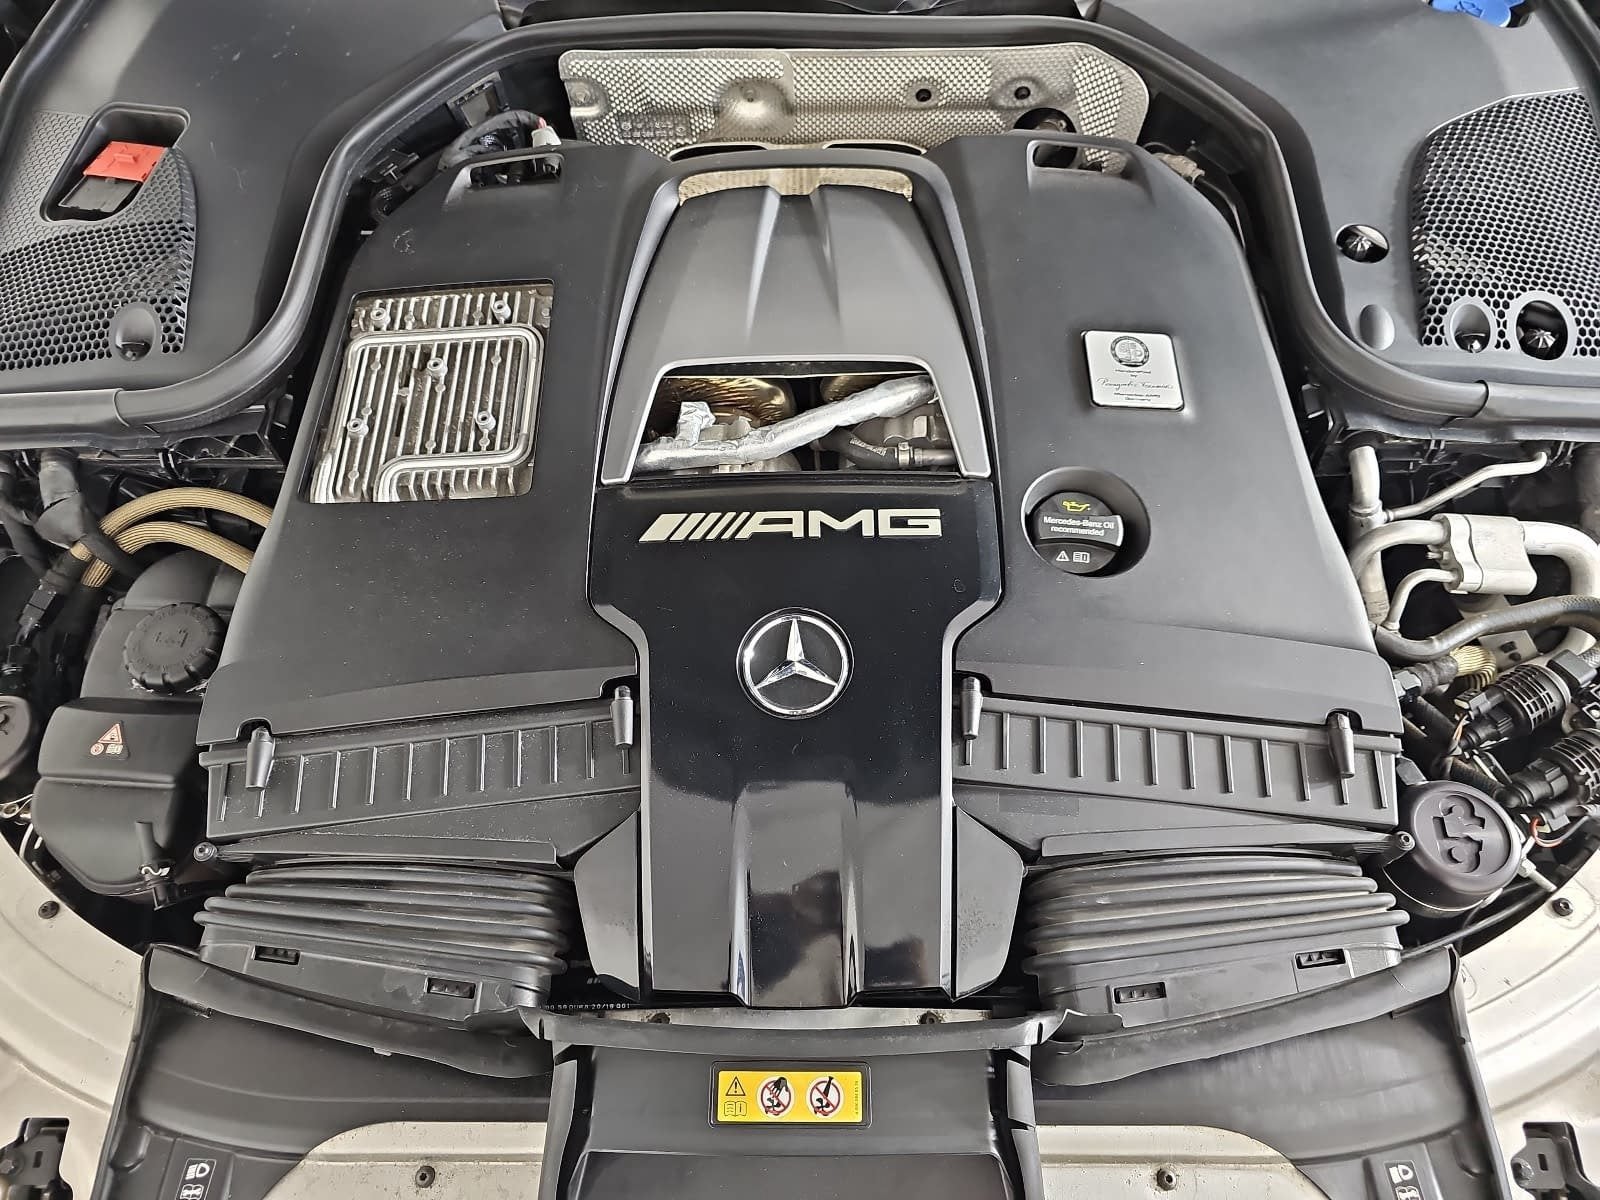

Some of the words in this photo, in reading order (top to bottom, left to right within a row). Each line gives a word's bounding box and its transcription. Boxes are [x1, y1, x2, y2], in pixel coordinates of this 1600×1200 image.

[735, 509, 942, 540] AMG
[1043, 516, 1103, 528] Mercedes-Benz
[1103, 521, 1114, 529] Oil
[1050, 526, 1105, 536] recommended
